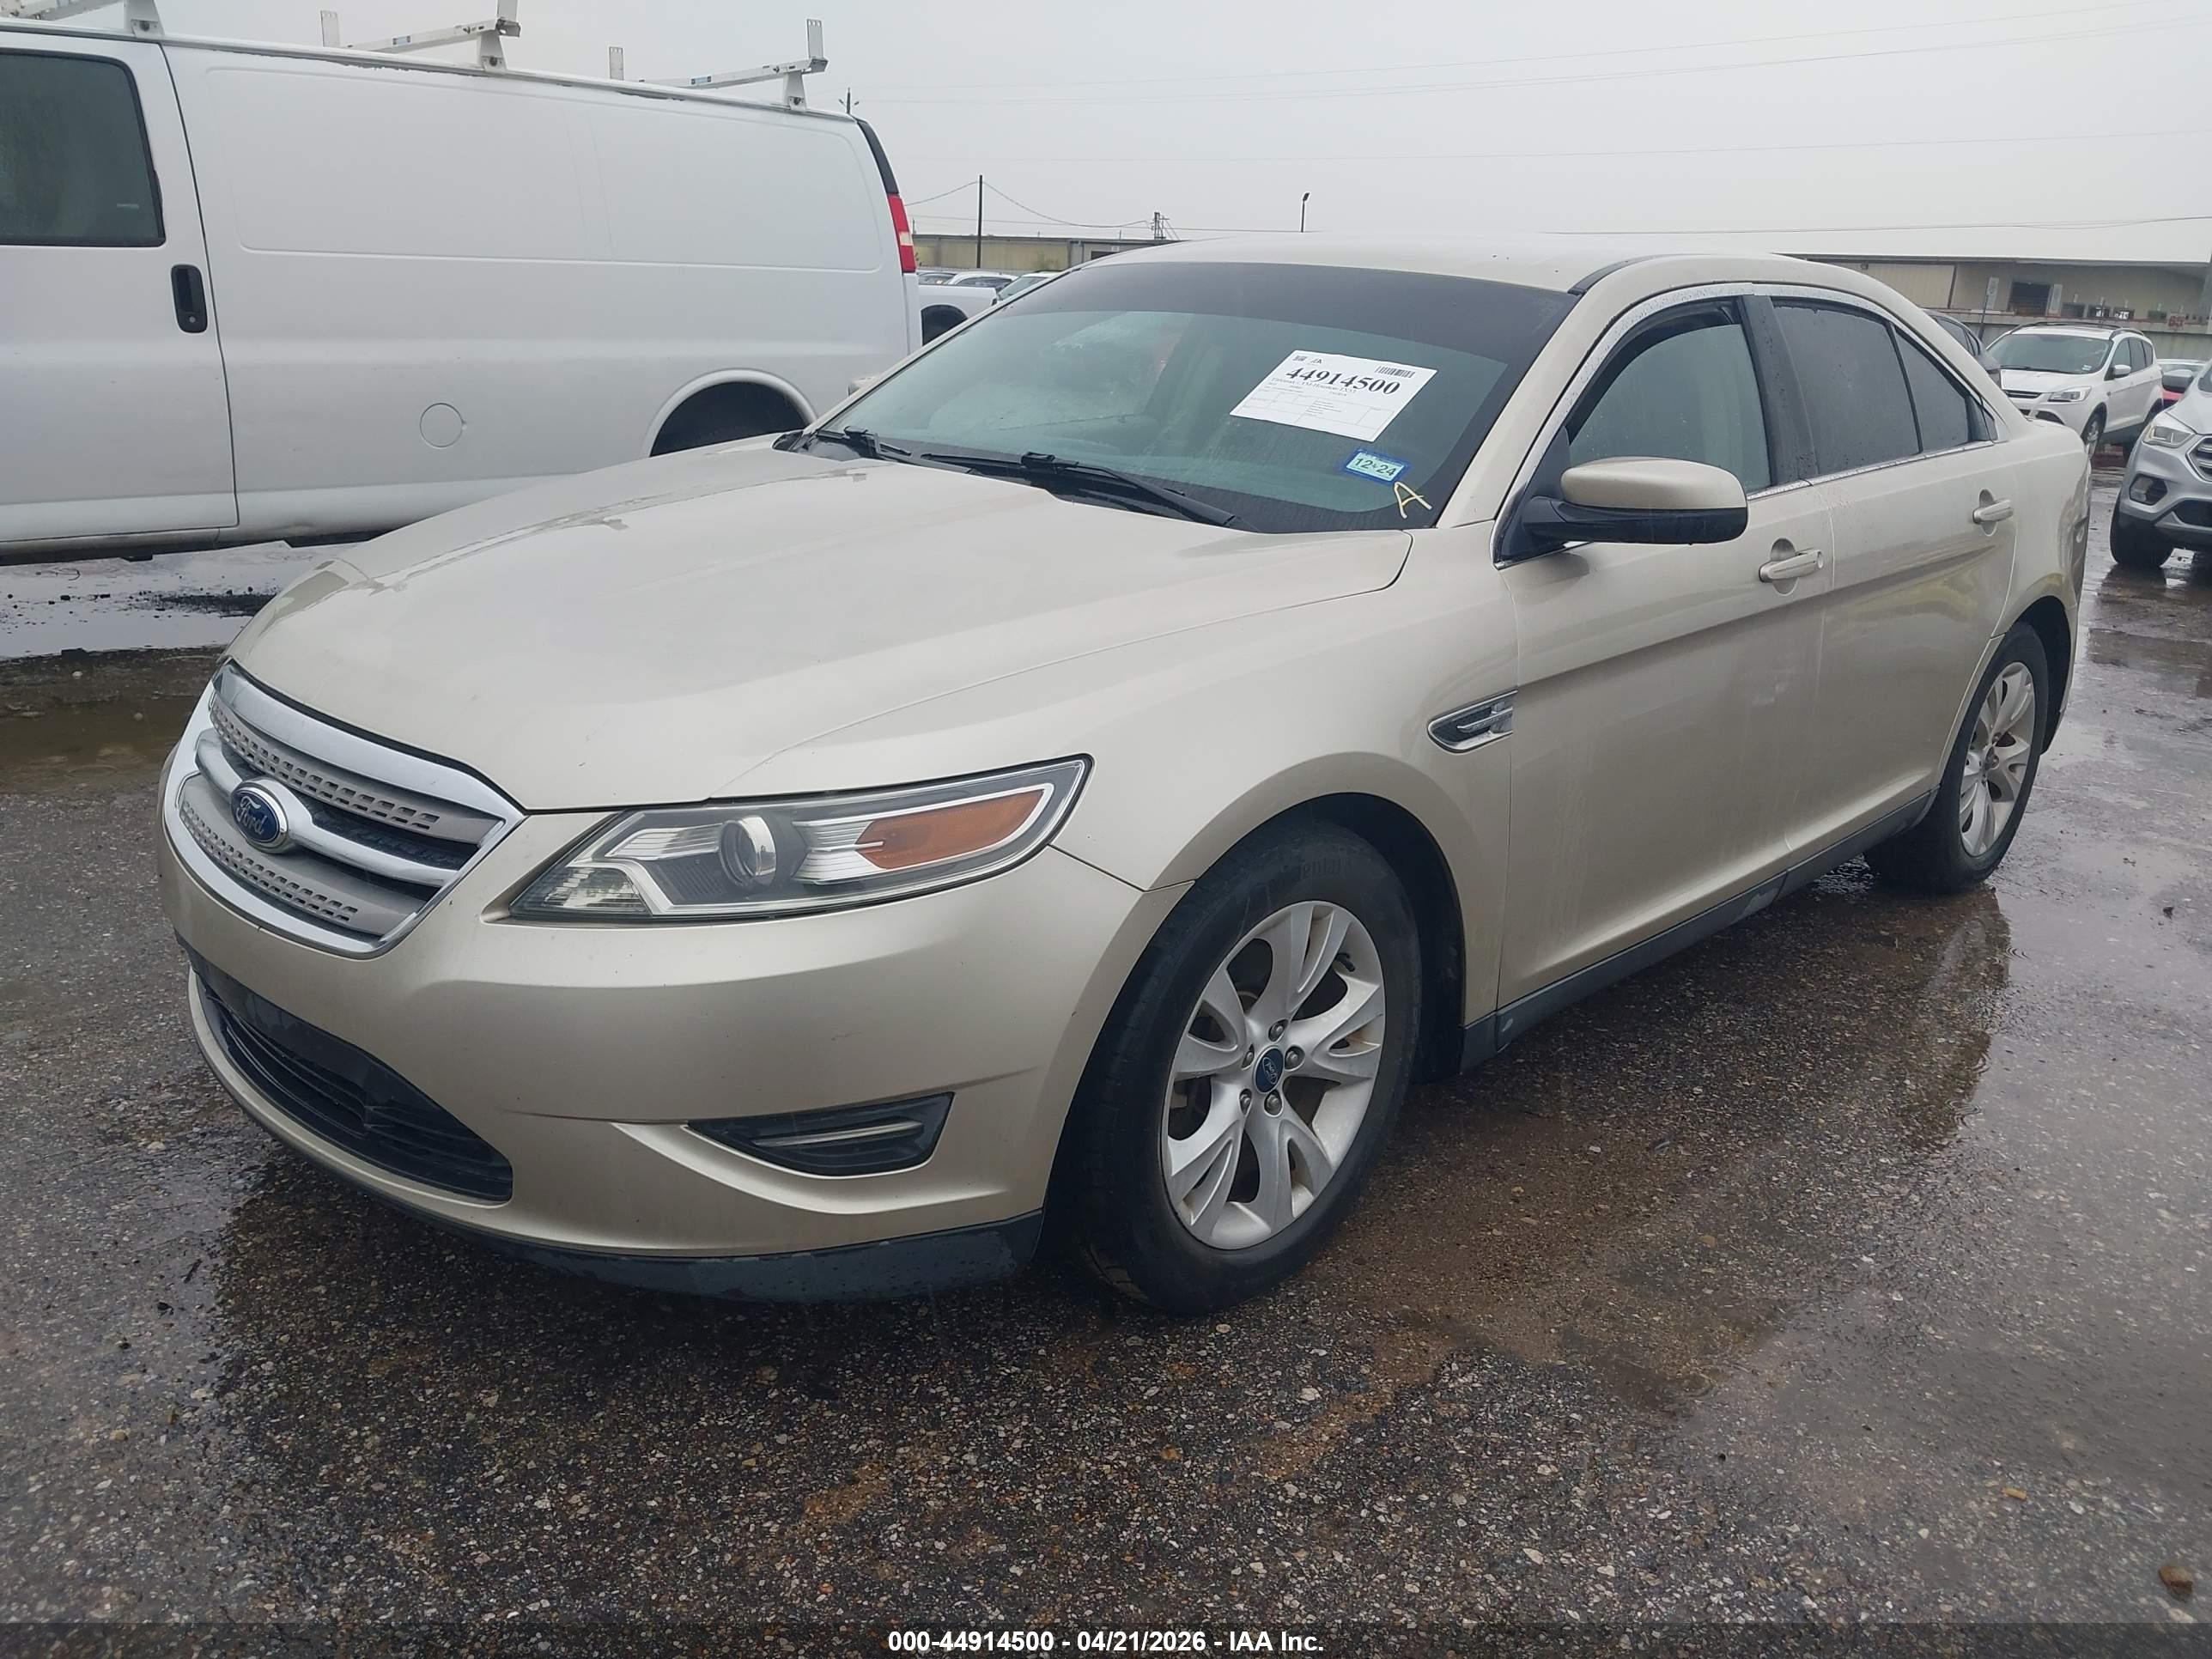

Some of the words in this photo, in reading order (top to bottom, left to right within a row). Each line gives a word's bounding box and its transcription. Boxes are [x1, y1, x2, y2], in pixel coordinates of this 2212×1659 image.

[1285, 368, 1401, 395] 44914500
[1394, 481, 1432, 519] A
[236, 795, 268, 835] Ford
